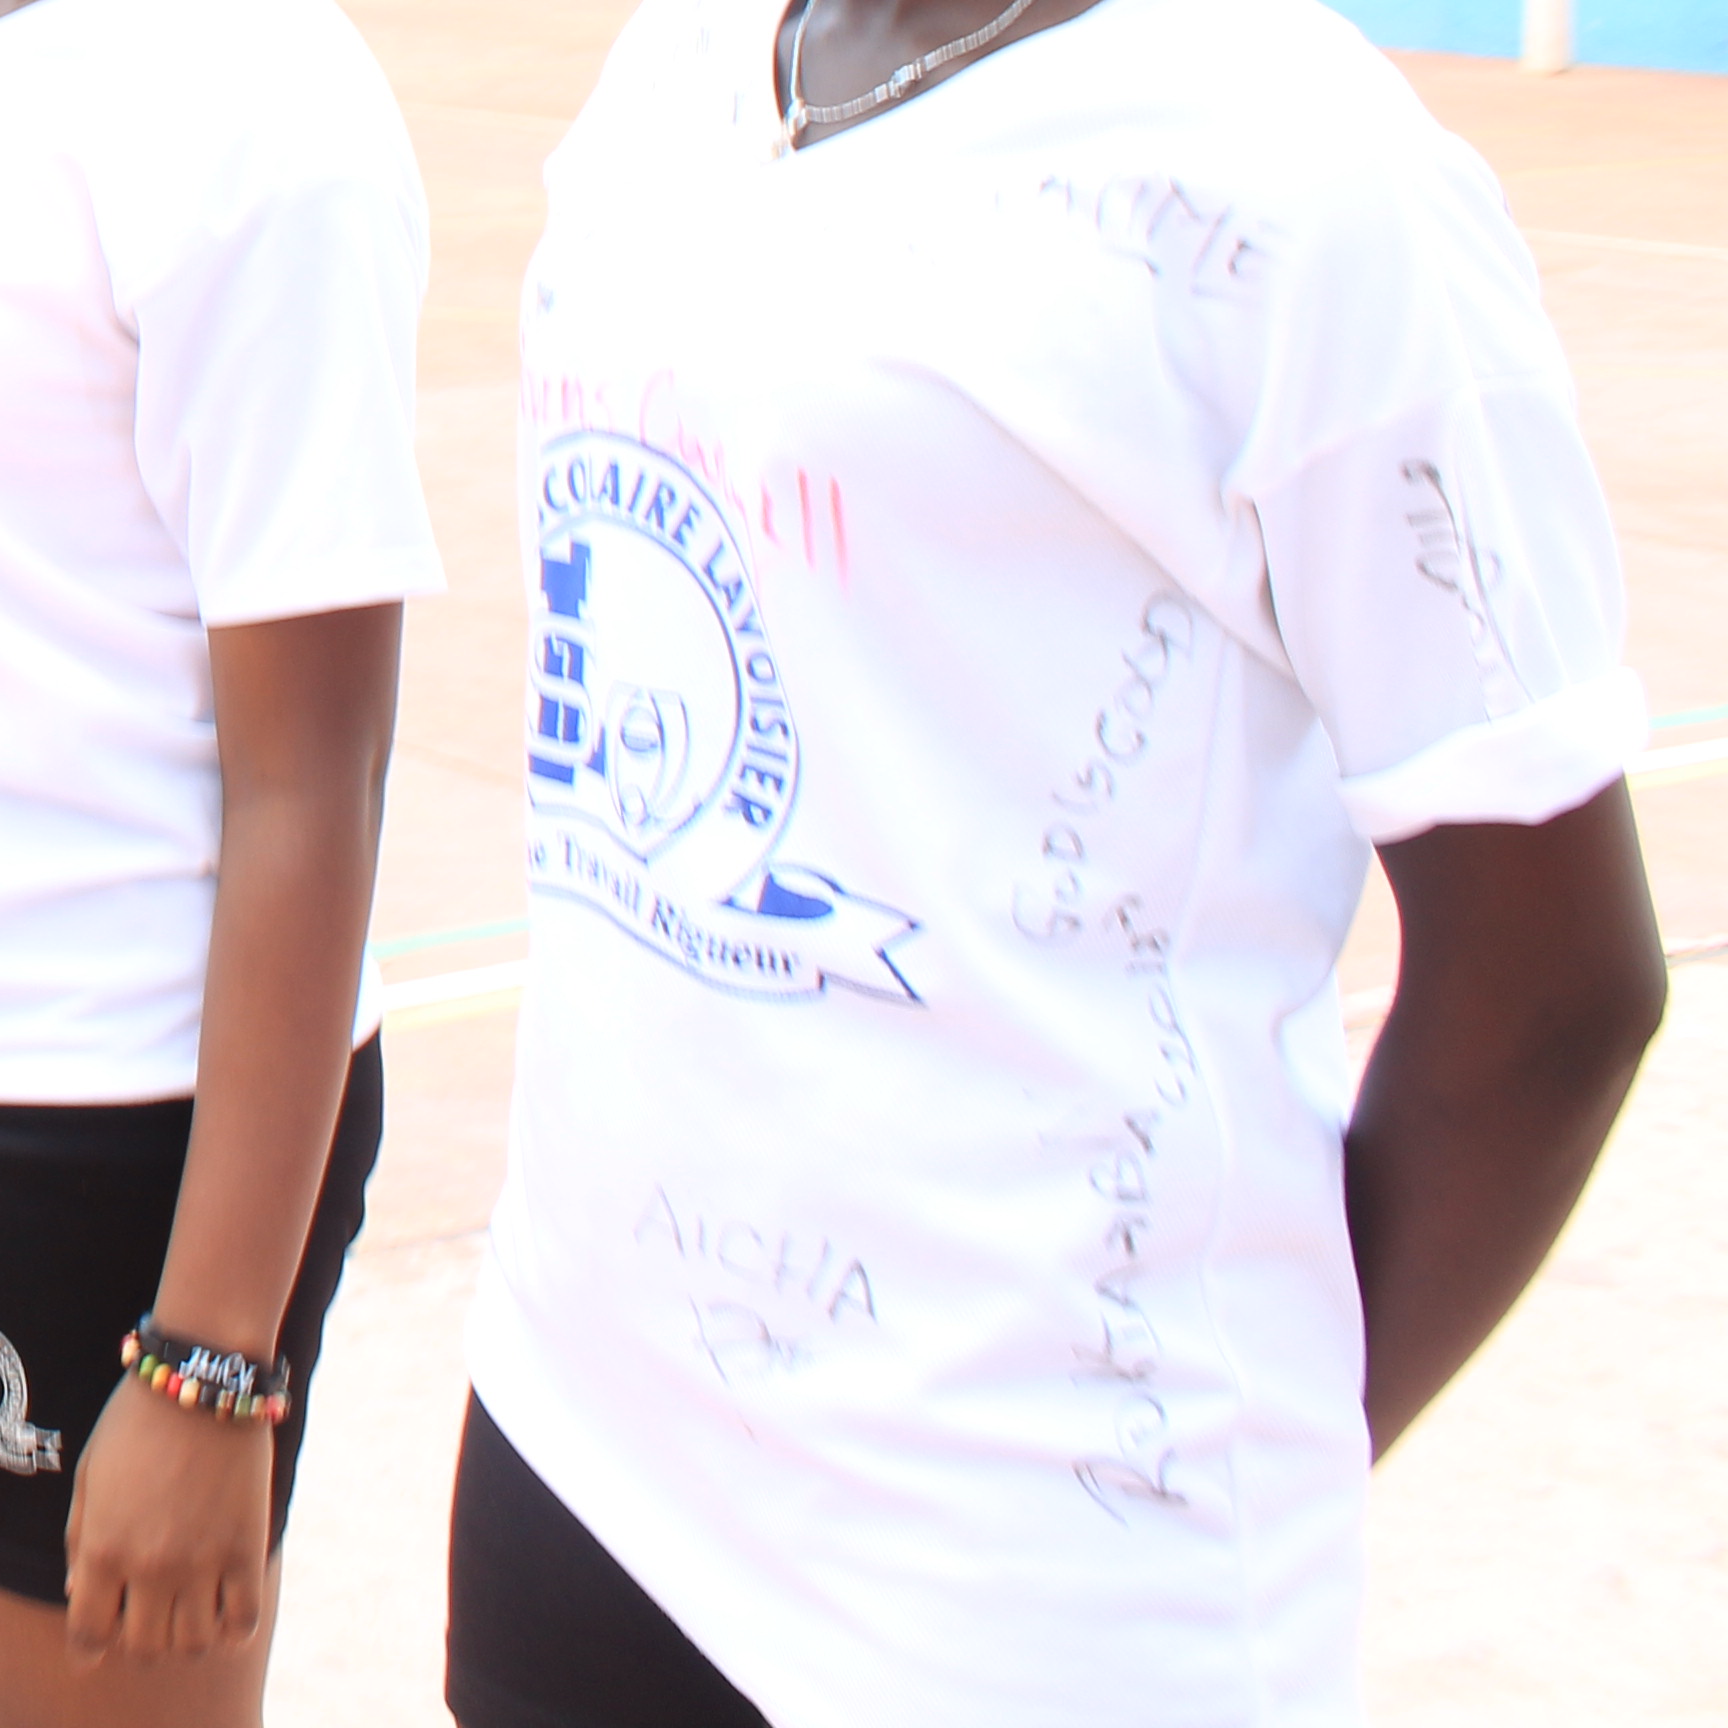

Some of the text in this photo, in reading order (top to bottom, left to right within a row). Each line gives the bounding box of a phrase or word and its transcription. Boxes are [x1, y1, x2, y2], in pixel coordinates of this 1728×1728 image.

[538, 456, 702, 550] COLAIRE
[700, 537, 792, 828] LAVOISIER
[649, 892, 802, 978] Rigueur
[631, 1180, 879, 1326] AICHA
